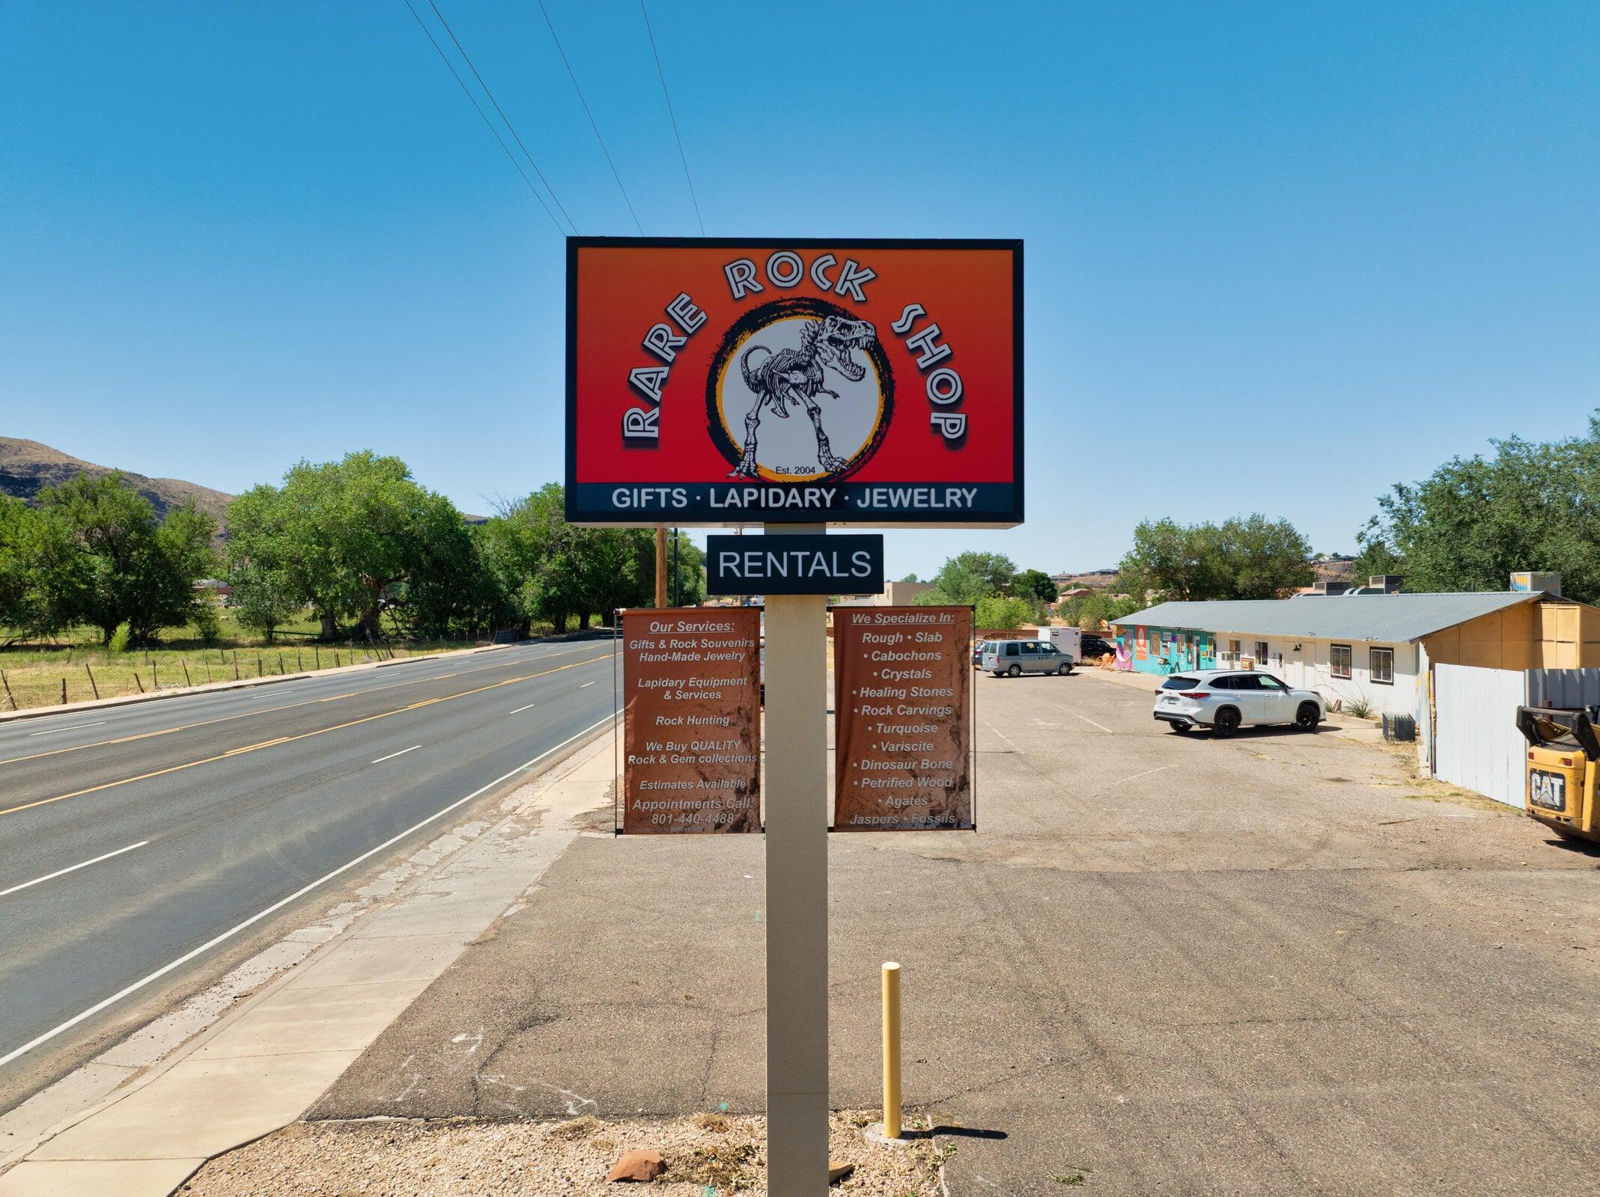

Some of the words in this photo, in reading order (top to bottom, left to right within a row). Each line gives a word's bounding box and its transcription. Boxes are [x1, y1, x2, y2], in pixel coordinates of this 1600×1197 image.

[621, 292, 708, 439] RARE
[723, 250, 877, 302] ROCK
[891, 303, 968, 442] SHOP
[775, 466, 792, 475] Est.
[794, 466, 816, 475] 2004
[612, 487, 688, 508] GIFTS
[710, 487, 836, 508] LAPIDARY
[856, 487, 978, 508] JEWELRY
[719, 551, 872, 578] RENTALS
[852, 614, 871, 624] We
[874, 613, 936, 625] Specialize
[939, 612, 955, 623] In:
[650, 621, 673, 632] Our
[676, 620, 735, 632] Services:
[630, 640, 655, 649] Gifts
[658, 640, 666, 649] &
[670, 639, 697, 649] Rock
[701, 638, 755, 649] Souvenirs
[862, 632, 903, 645] Rough
[915, 632, 943, 642] Slab
[639, 653, 700, 662] Hand-Made
[703, 652, 746, 663] Jewelry
[871, 650, 942, 661] Cabochons
[881, 668, 932, 681] Crystals
[638, 678, 685, 689] Lapidary
[688, 677, 747, 688] Equipment
[663, 691, 671, 700] &
[675, 690, 722, 699] Services
[860, 687, 906, 699] Healing
[910, 687, 953, 697] Stones
[861, 705, 893, 715] Rock
[897, 704, 952, 717] Carvings
[656, 716, 683, 725] Rock
[687, 716, 730, 726] Hunting
[876, 723, 938, 735] Turquoise
[646, 742, 663, 751] We
[665, 742, 688, 753] Buy
[691, 740, 742, 751] QUALITY
[881, 741, 934, 751] Variscite
[628, 755, 656, 764] Rock
[659, 755, 667, 764] &
[670, 755, 696, 764] Gem
[699, 754, 757, 763] collections
[860, 759, 917, 770] Dinosaur
[920, 759, 953, 769] Bone
[640, 780, 693, 790] Estimates
[696, 779, 746, 789] Available
[861, 777, 913, 788] Petrified
[917, 777, 953, 787] Wood
[1531, 773, 1563, 806] CAT
[632, 799, 721, 811] Appointments
[885, 796, 928, 808] Agates
[652, 813, 734, 824] 801-440-4488
[850, 814, 899, 825] Jaspers
[910, 813, 956, 824] Fossils
